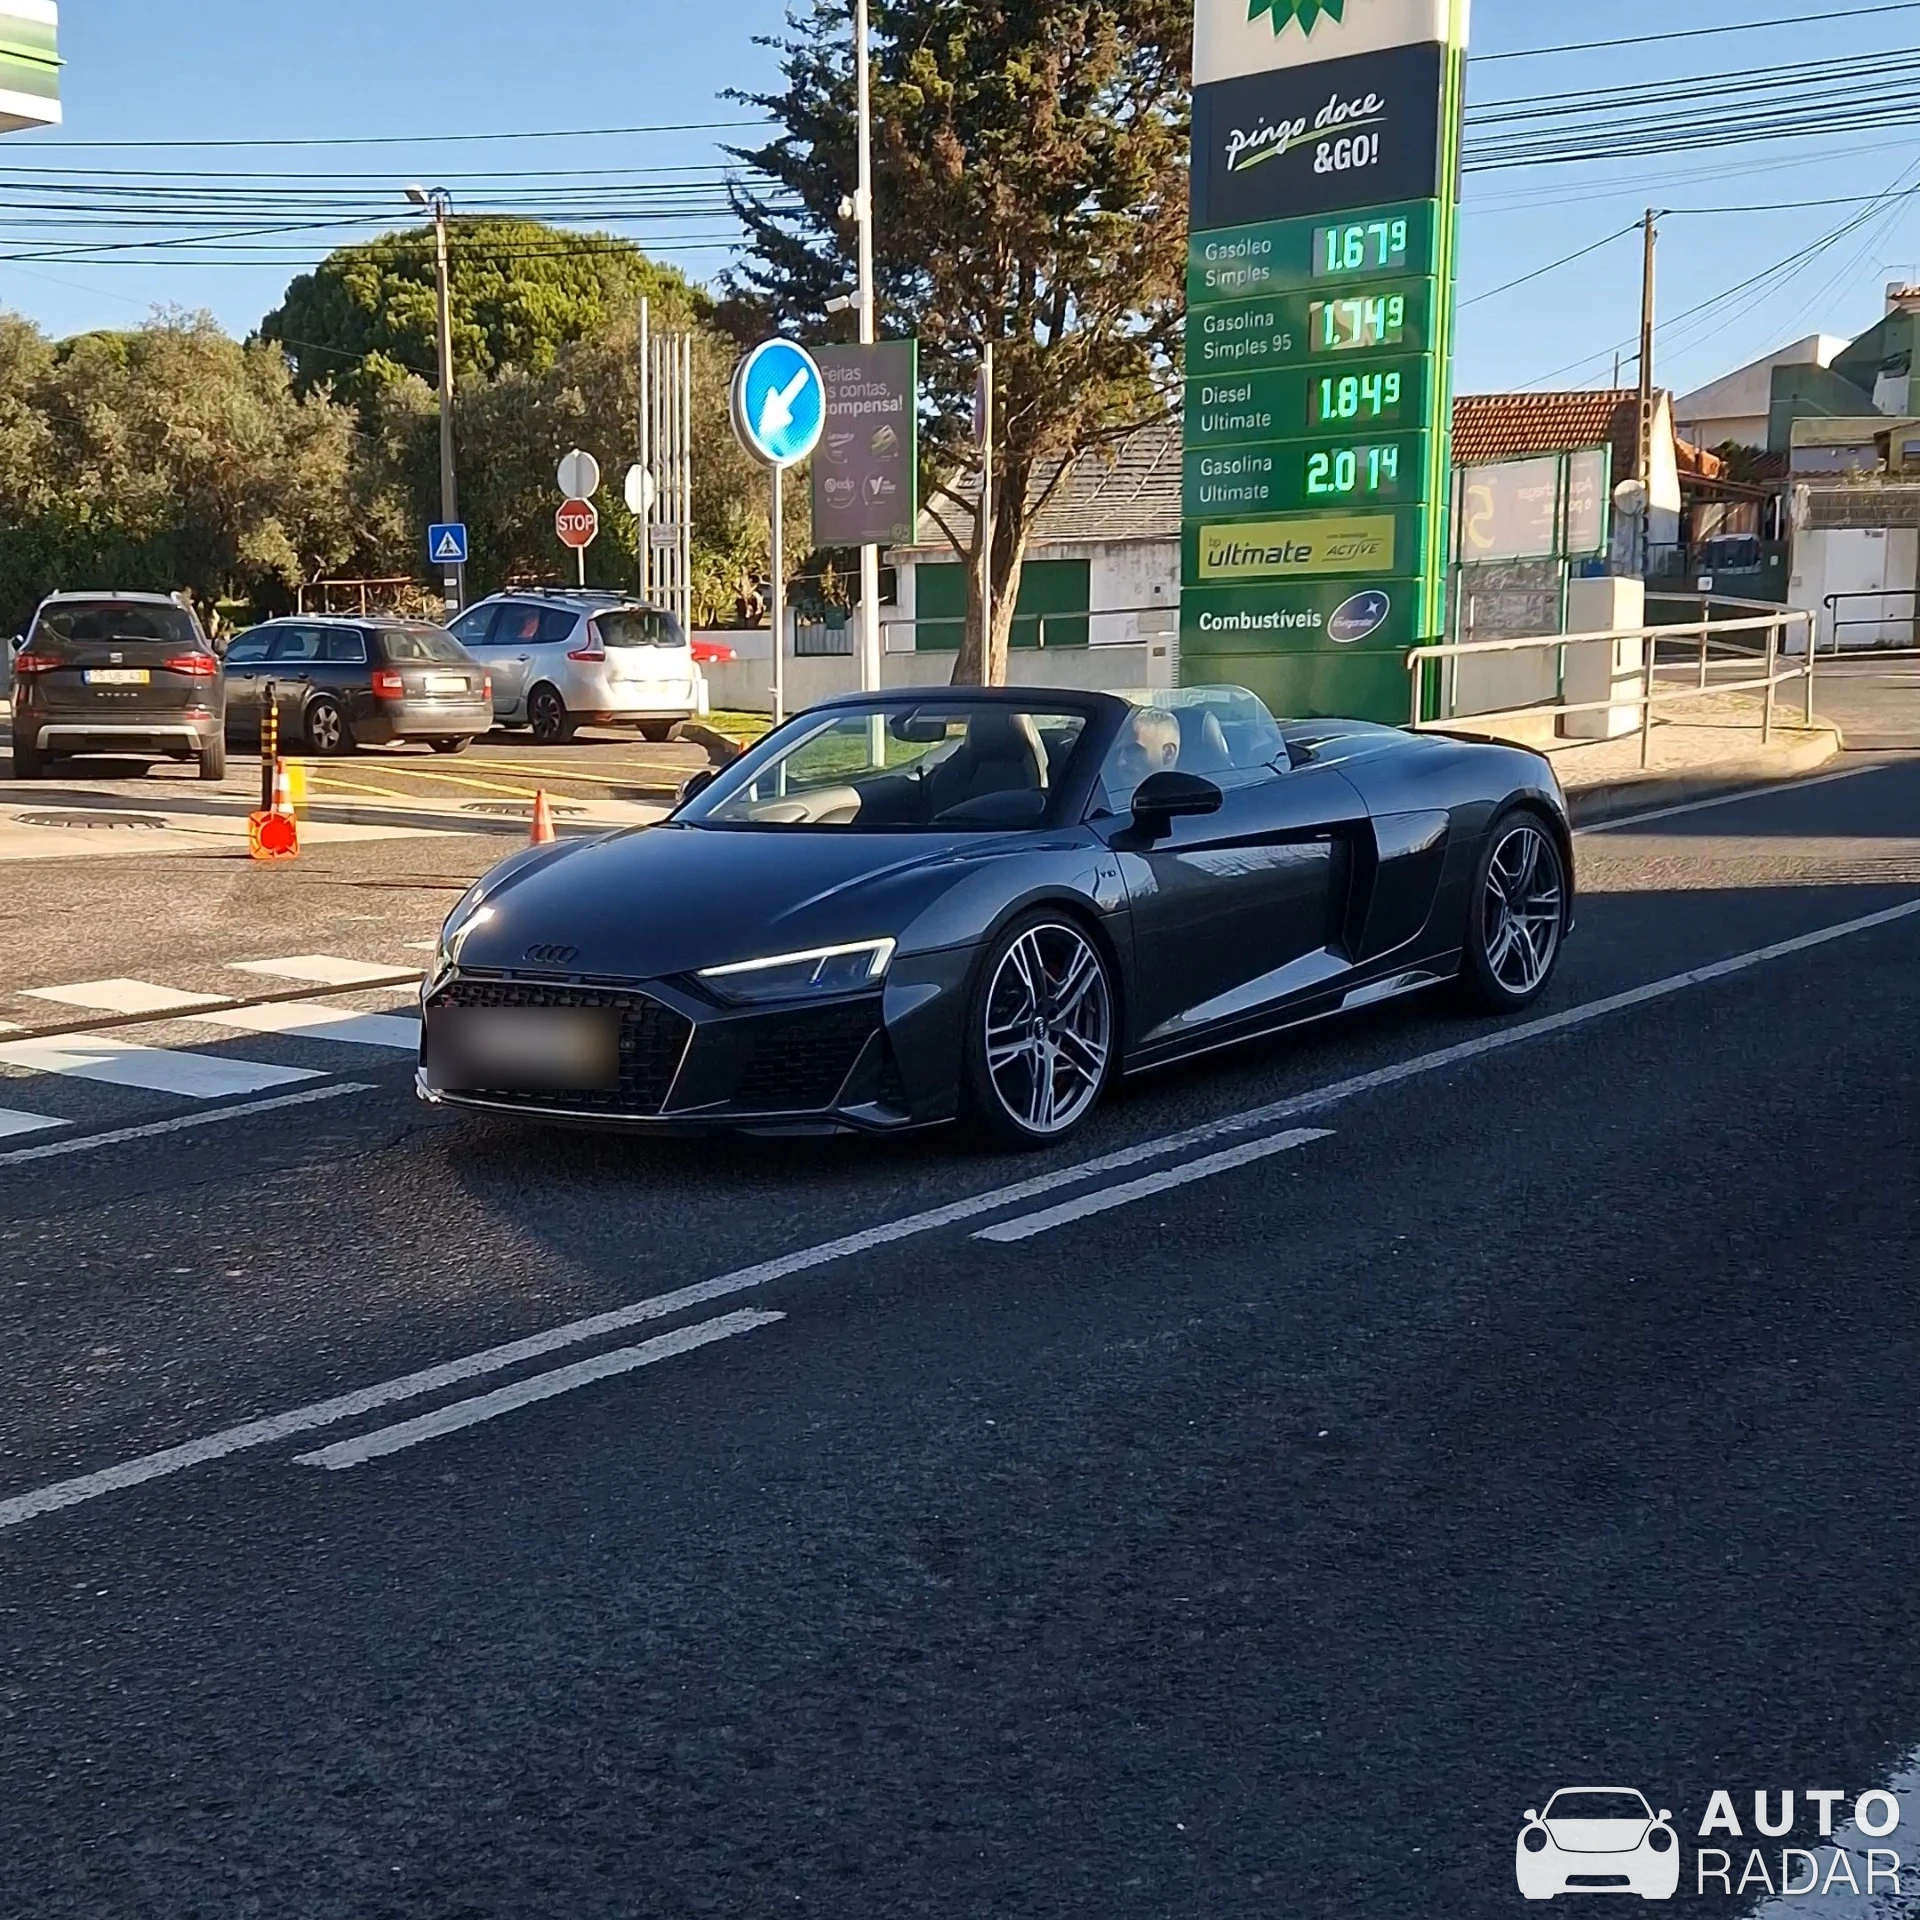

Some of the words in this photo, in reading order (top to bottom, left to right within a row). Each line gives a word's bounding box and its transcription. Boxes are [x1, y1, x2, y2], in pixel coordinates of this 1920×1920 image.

[1225, 117, 1306, 171] pingo
[1314, 92, 1385, 129] doce
[1313, 133, 1379, 173] &GO!
[1205, 237, 1271, 261] Gasóleo
[1326, 220, 1408, 271] 1.679
[1205, 264, 1271, 287] Simples
[1203, 310, 1275, 333] Gasolina
[1323, 296, 1405, 345] 1.749
[1203, 338, 1267, 360] Simples
[1272, 334, 1292, 351] 95
[840, 382, 891, 398] contas,
[1201, 384, 1251, 405] Diesel
[1320, 372, 1401, 420] 1.849
[828, 394, 903, 418] ompensa!
[1201, 412, 1272, 432] Ultimate
[1200, 455, 1272, 476] Gasolina
[1199, 483, 1269, 503] Ultimate
[559, 514, 594, 531] STOP
[1208, 540, 1312, 567] ultimate
[1326, 541, 1381, 560] ACTIVE
[1199, 608, 1323, 631] Combustíveis
